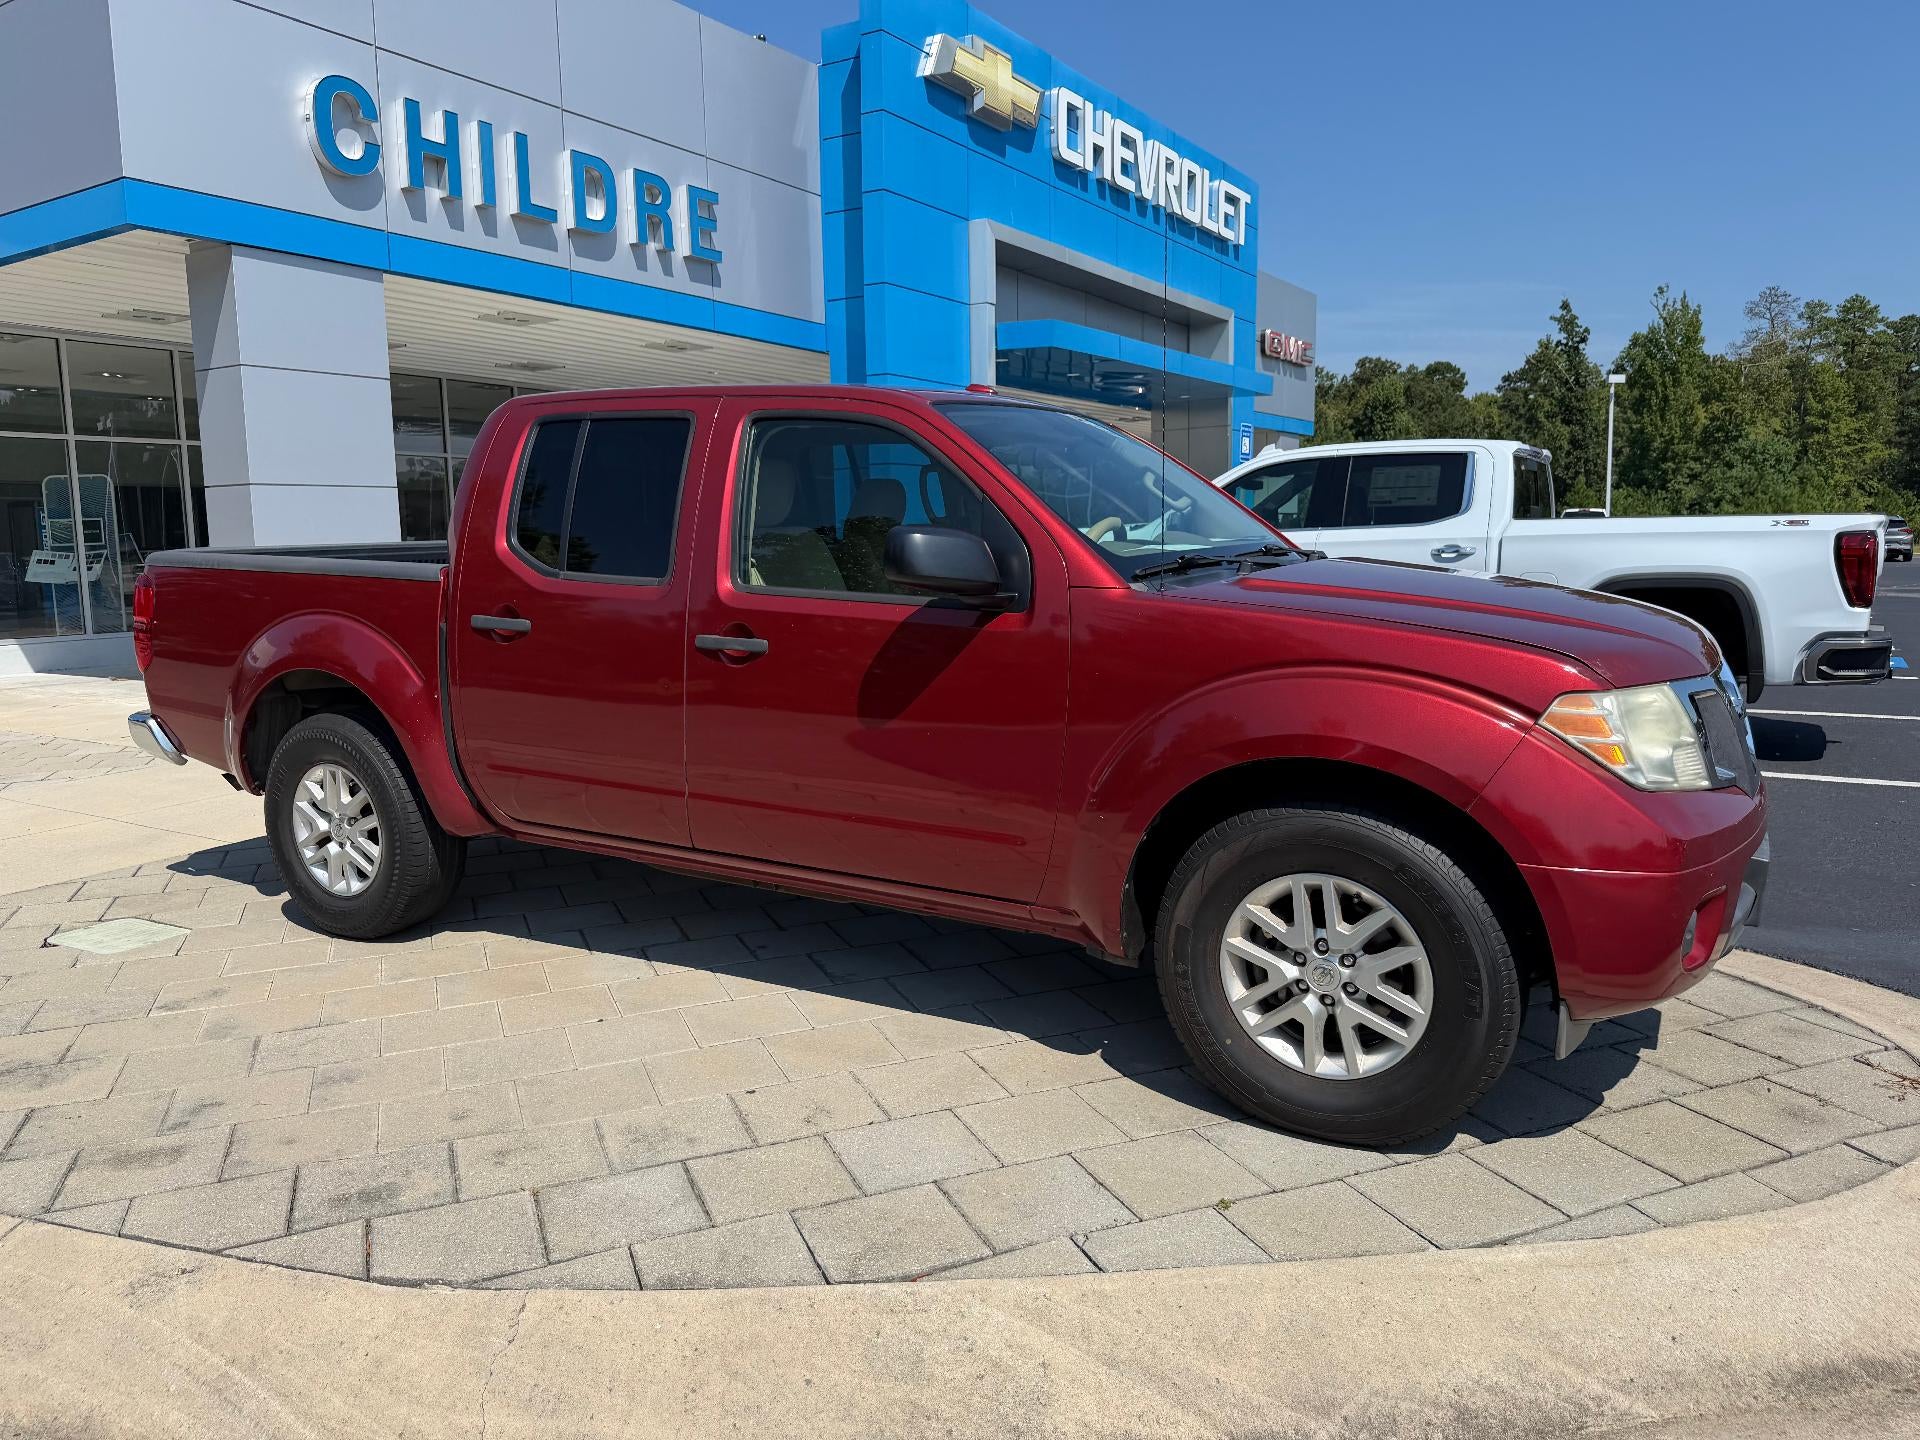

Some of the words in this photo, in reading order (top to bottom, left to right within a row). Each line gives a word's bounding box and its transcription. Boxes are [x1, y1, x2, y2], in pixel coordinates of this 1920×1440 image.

[306, 75, 722, 263] CHILDRE
[1051, 86, 1251, 246] CHEVROLET
[1265, 329, 1313, 366] GMC
